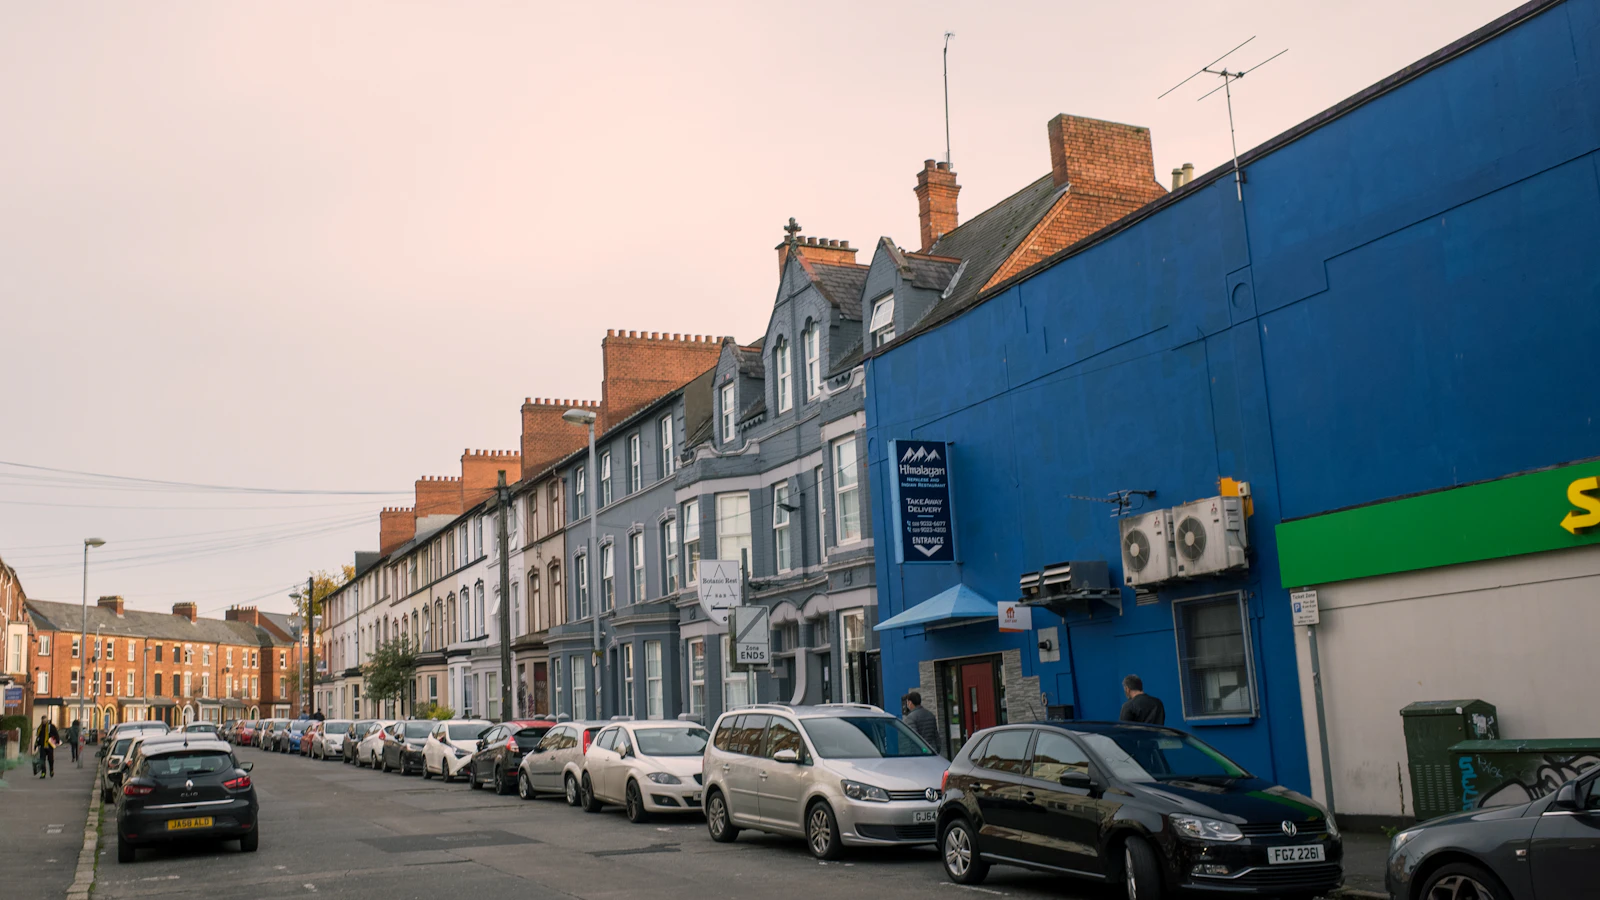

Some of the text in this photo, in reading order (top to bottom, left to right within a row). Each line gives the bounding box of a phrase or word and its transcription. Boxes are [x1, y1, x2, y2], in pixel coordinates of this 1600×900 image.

[899, 464, 945, 477] Himalayan
[906, 497, 943, 505] TAKEAWAY
[912, 536, 944, 544] ENTRANCE
[740, 652, 764, 660] ENDS
[916, 812, 936, 821] GJ64
[194, 818, 210, 826] ALD
[1275, 847, 1319, 861] FGZ 2261
